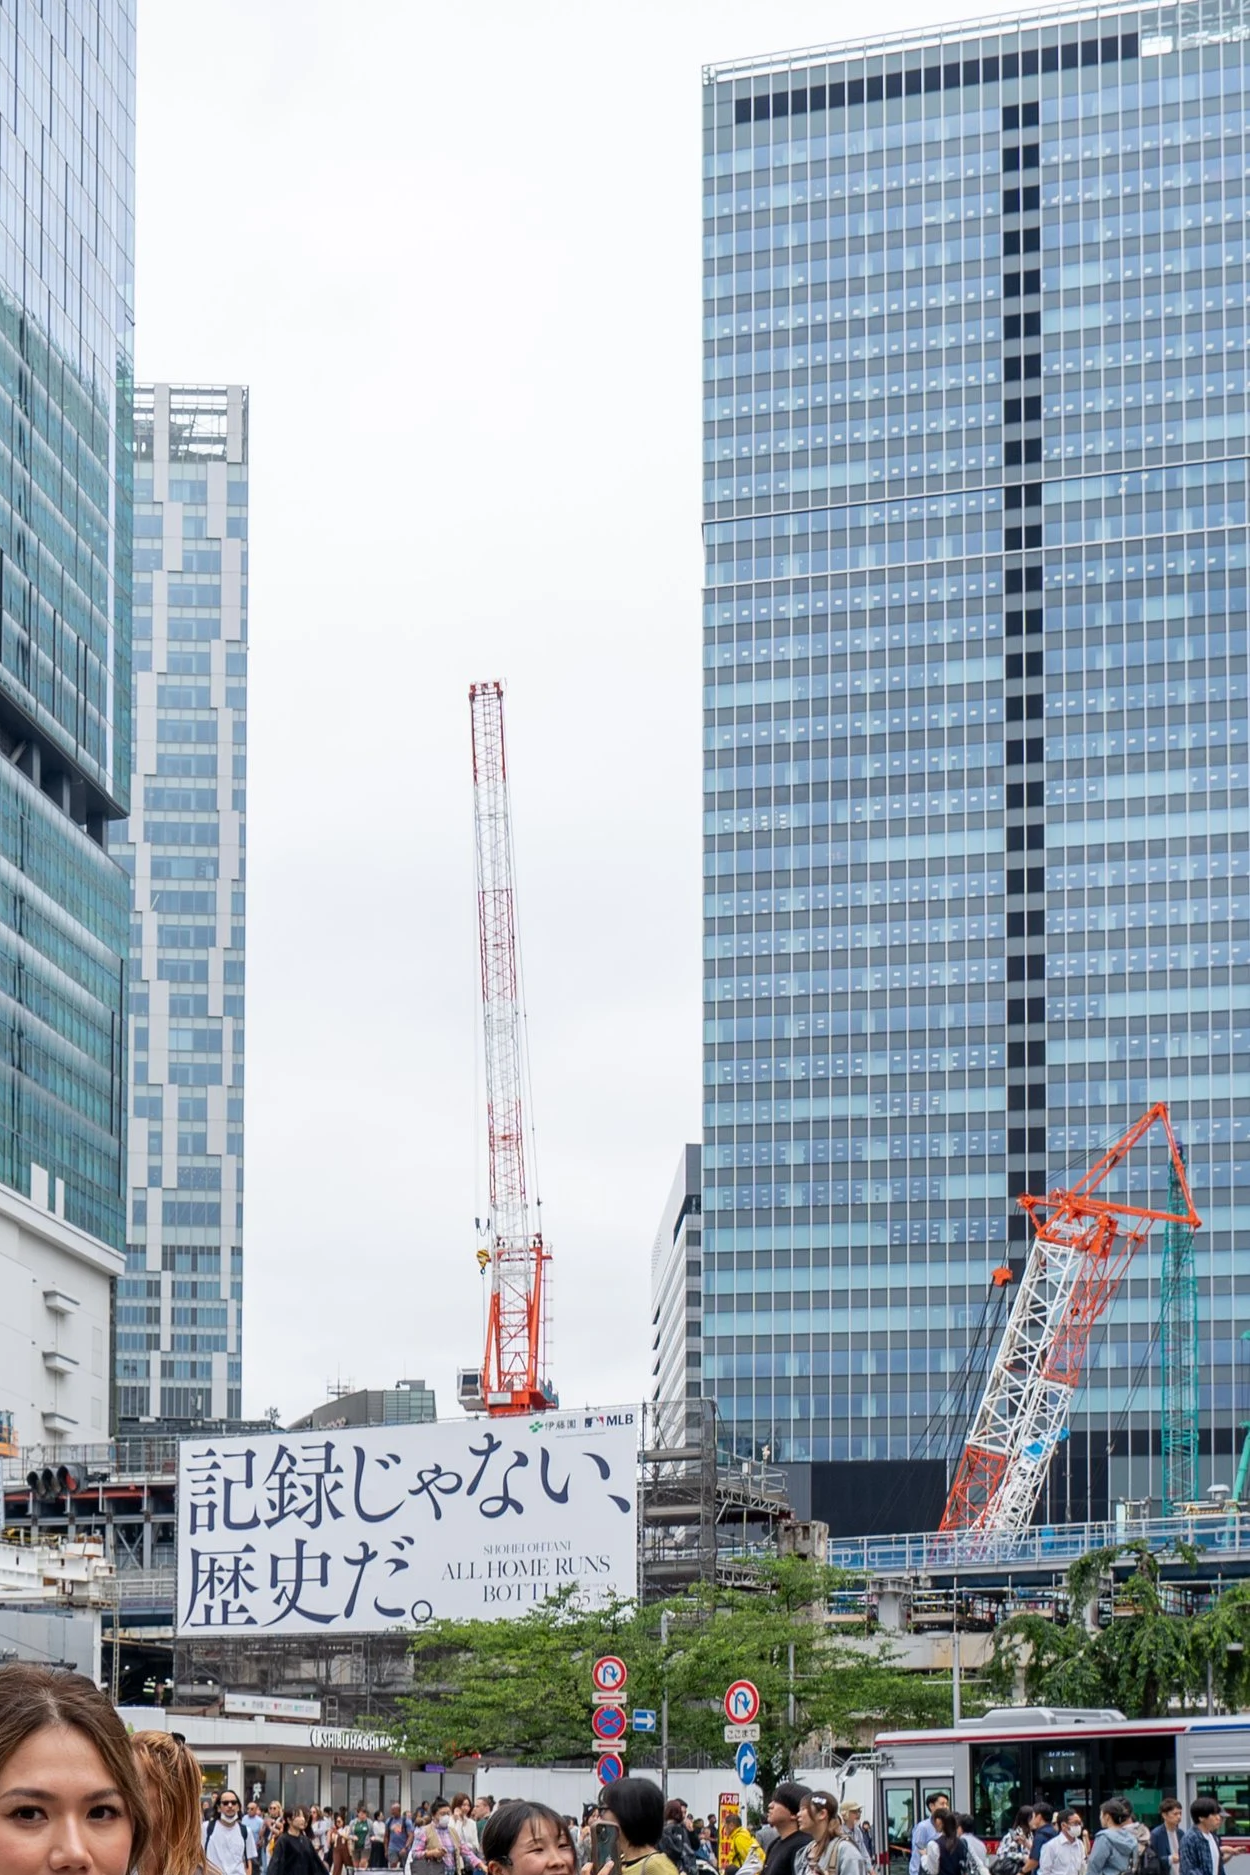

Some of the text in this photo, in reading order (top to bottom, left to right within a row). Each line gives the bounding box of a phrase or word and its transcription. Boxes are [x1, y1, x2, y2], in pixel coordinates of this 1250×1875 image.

[606, 1413, 634, 1426] MLB
[185, 1431, 631, 1536] 記録じゃない、
[484, 1541, 571, 1555] SHOHEI OHTANI
[442, 1555, 610, 1580] ALL HOME RUNS
[181, 1535, 434, 1629] 歴史だ。
[321, 1731, 349, 1749] SHIBU
[350, 1733, 379, 1751] HACHI
[727, 1728, 757, 1739] ここまで
